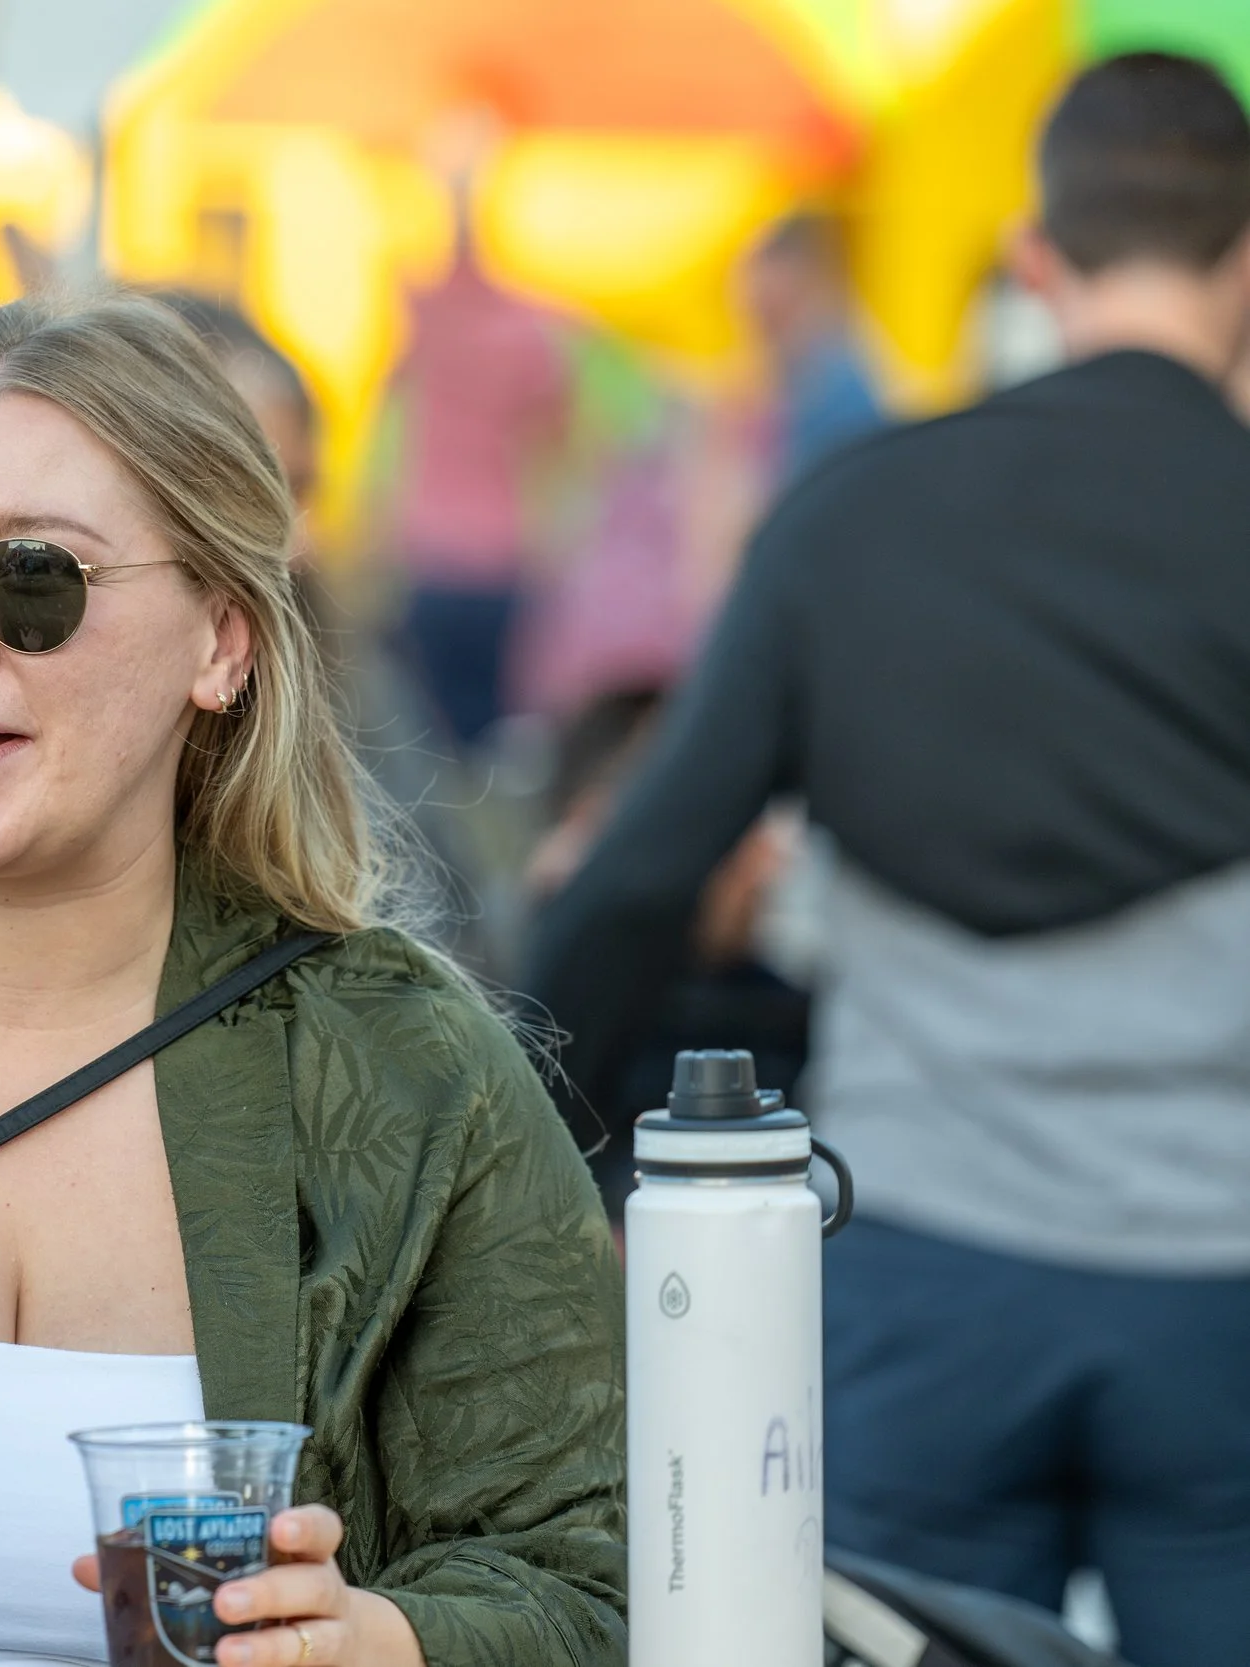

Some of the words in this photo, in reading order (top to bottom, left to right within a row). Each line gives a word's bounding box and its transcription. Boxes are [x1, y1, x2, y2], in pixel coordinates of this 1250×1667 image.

[761, 1386, 822, 1497] Ail
[155, 1517, 195, 1541] LOST
[199, 1514, 262, 1540] AVIATOR
[668, 1449, 684, 1594] ThermoFlask
